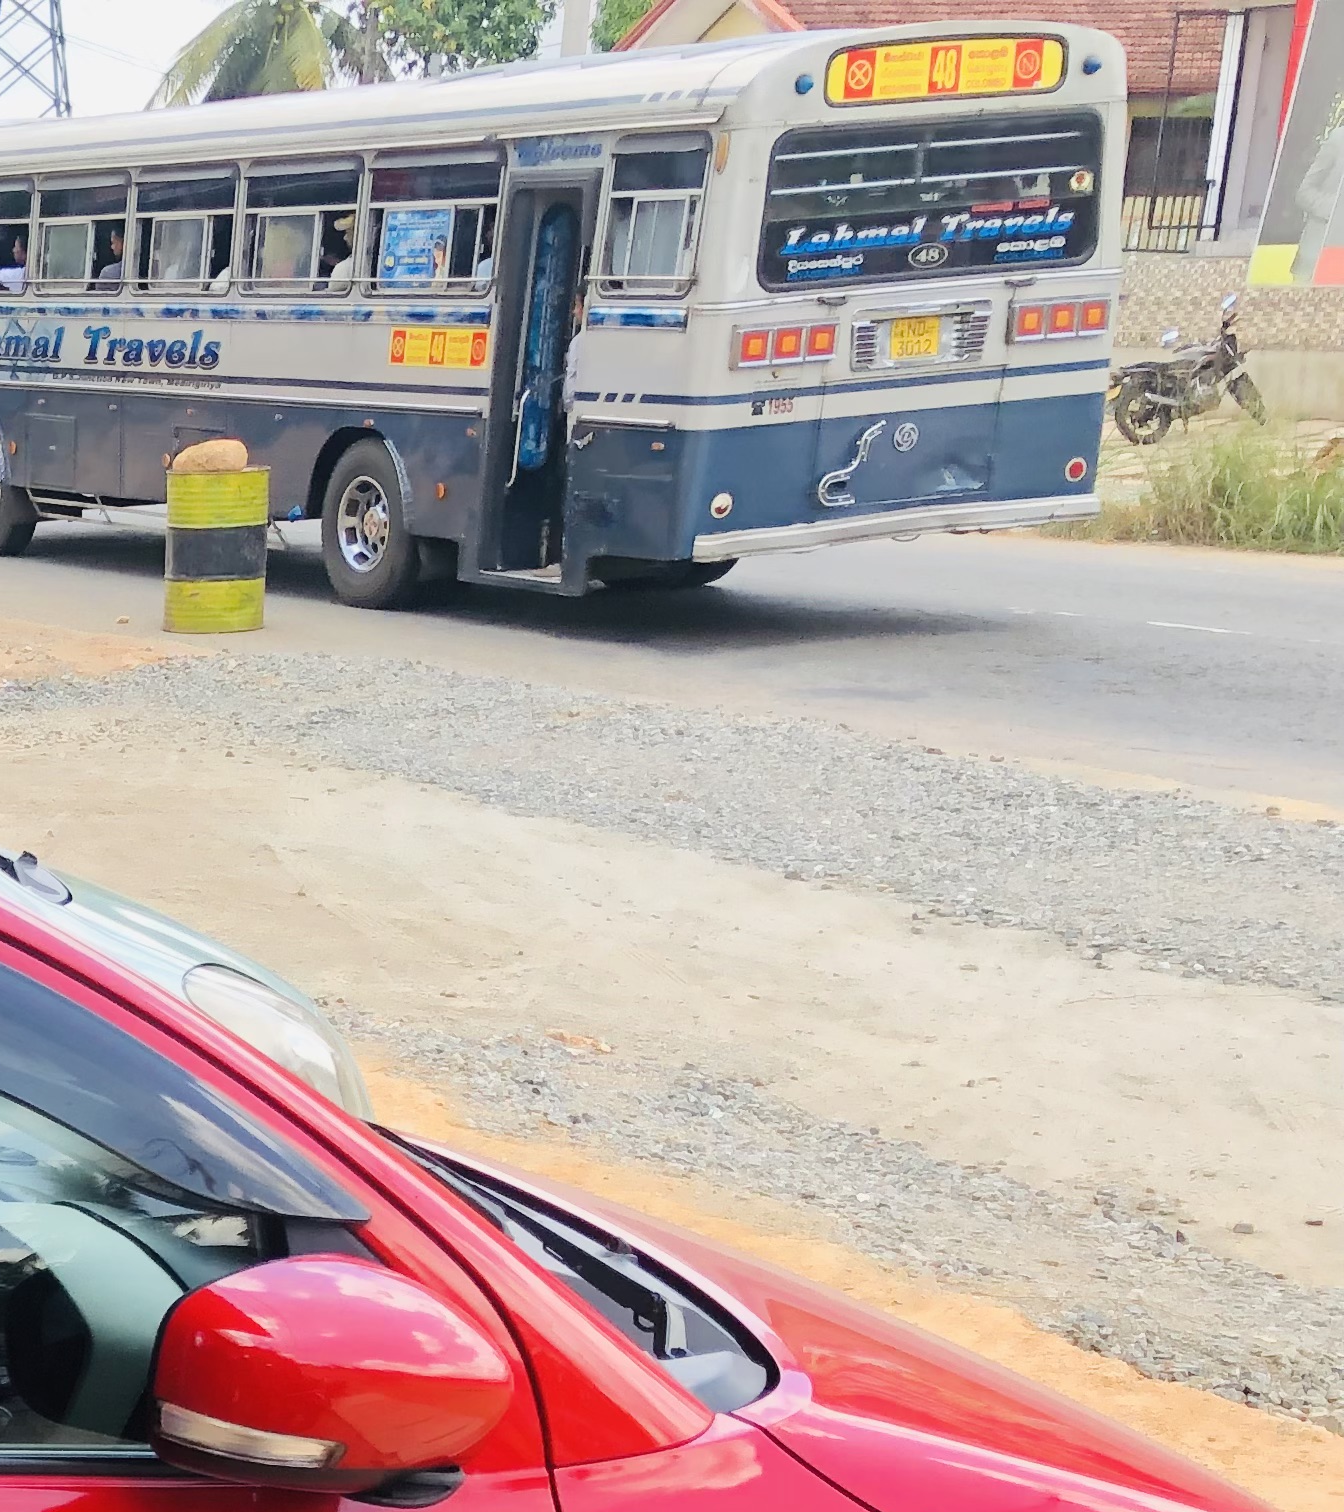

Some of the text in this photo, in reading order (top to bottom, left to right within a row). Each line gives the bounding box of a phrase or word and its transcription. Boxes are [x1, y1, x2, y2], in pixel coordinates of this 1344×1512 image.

[933, 49, 958, 90] 48
[780, 205, 1076, 256] Lahmal Travels
[915, 248, 940, 263] 48
[83, 325, 221, 369] Travels
[896, 338, 932, 357] 3012
